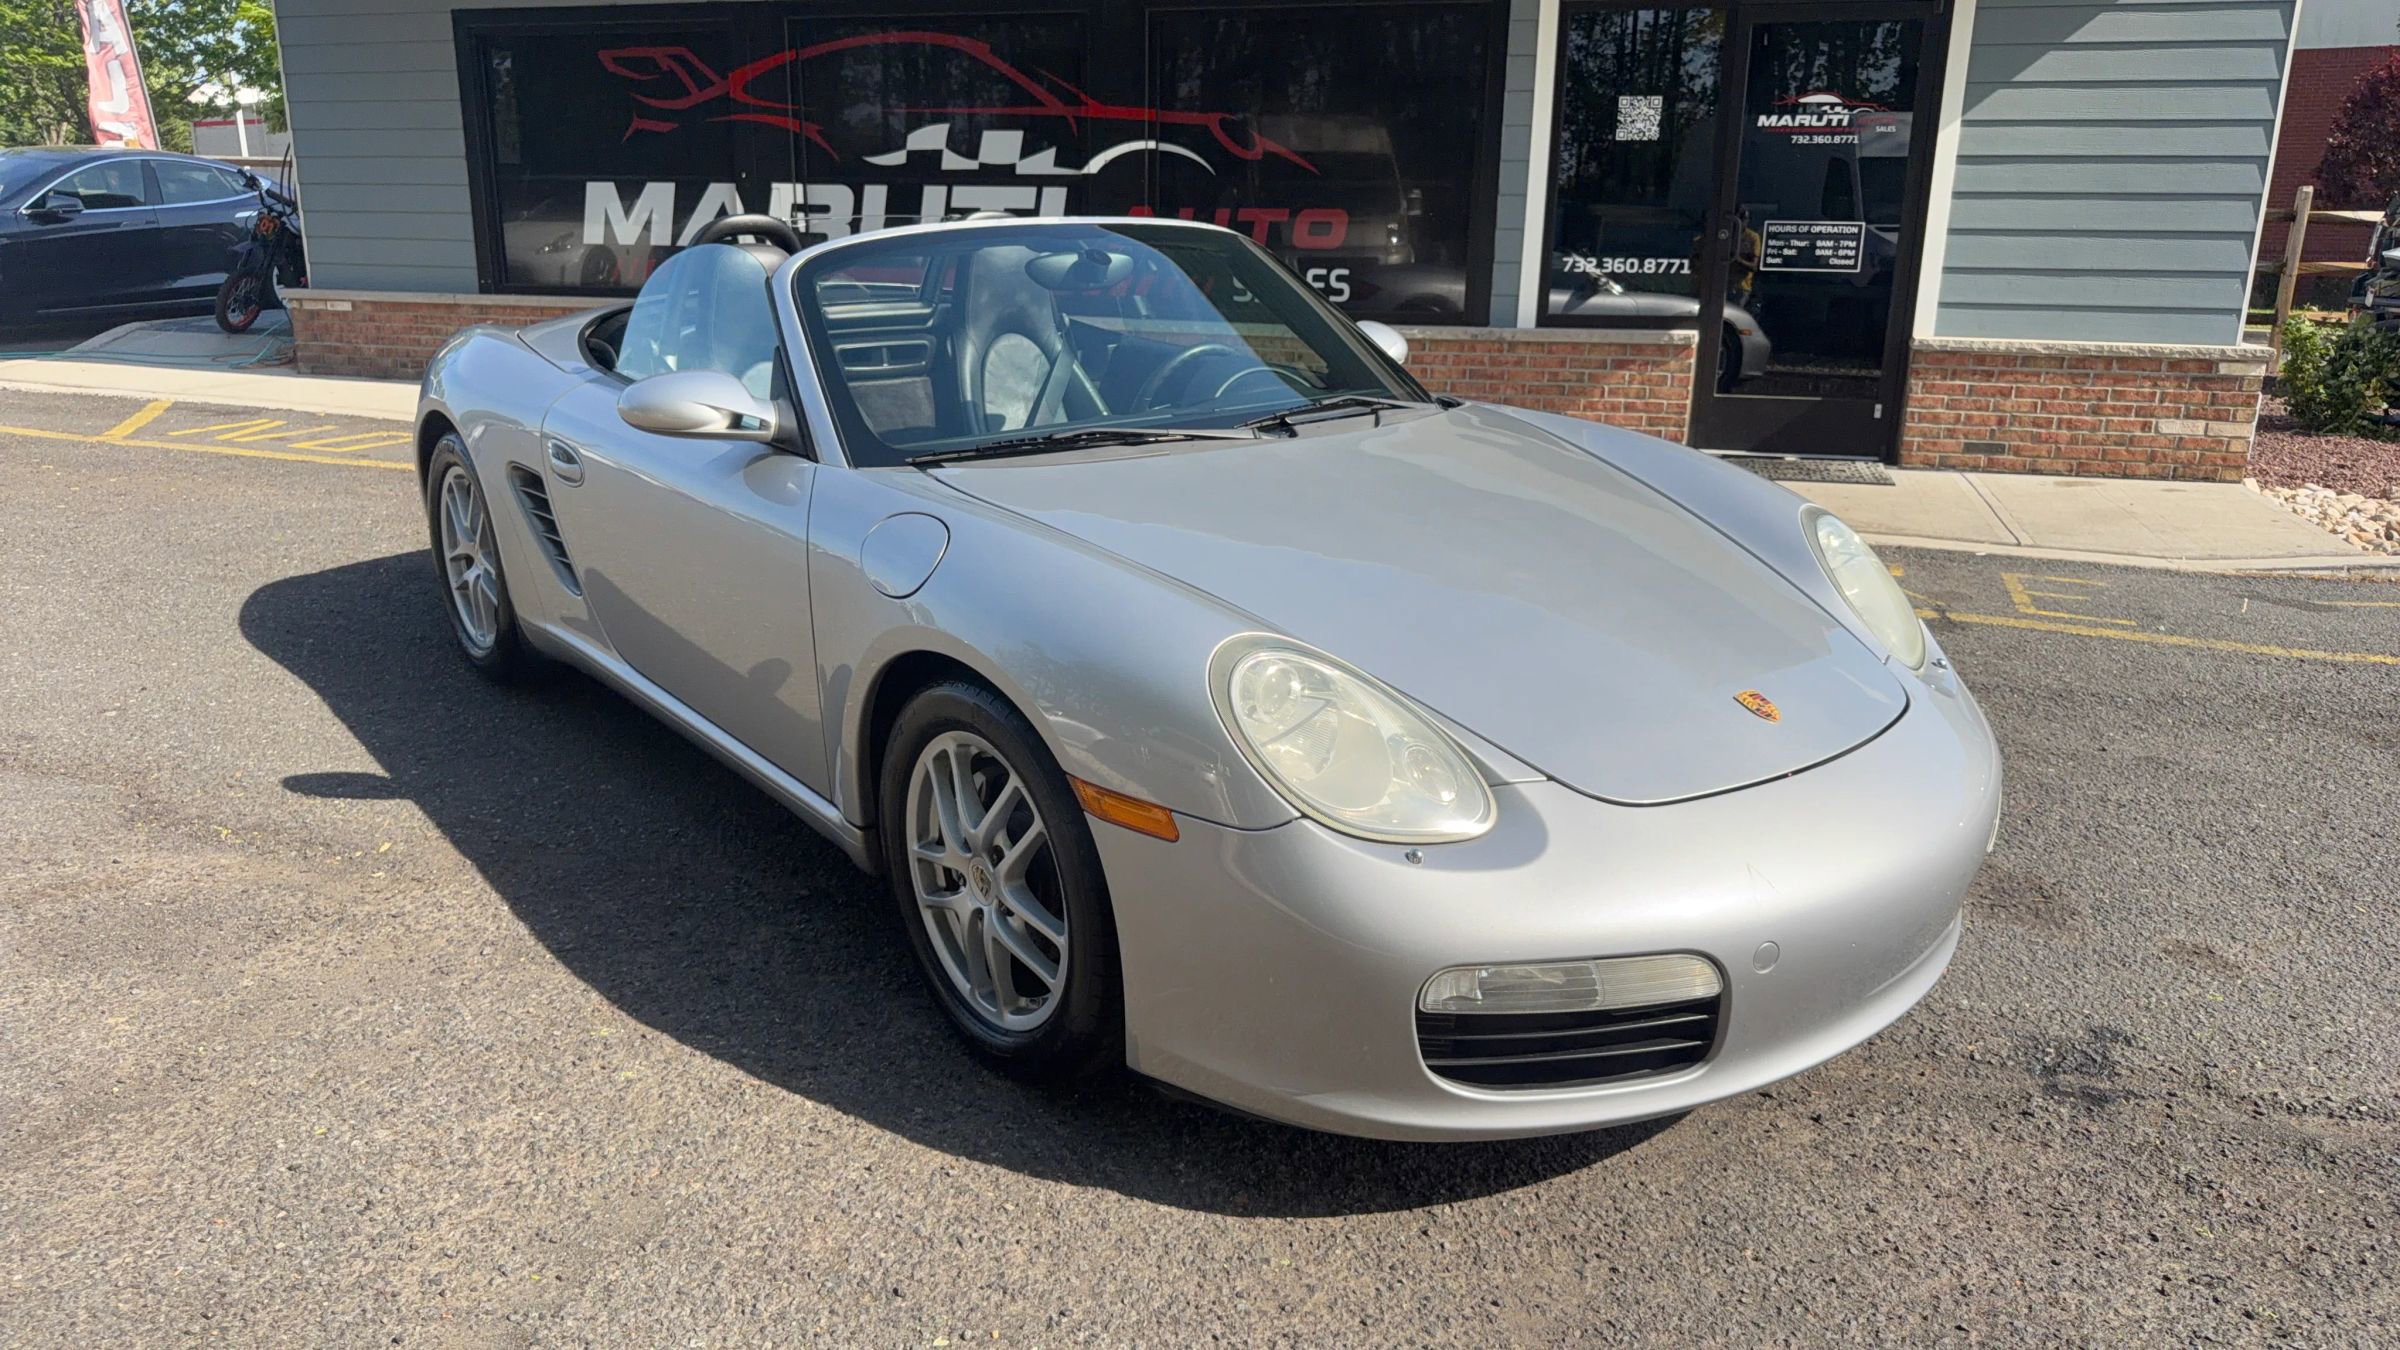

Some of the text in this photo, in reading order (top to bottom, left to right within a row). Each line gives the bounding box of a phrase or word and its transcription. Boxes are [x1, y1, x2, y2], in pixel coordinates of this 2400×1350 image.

[1757, 114, 1850, 127] MARUTI
[1875, 125, 1897, 133] SALES
[1791, 135, 1859, 144] 732.360.8771
[1128, 206, 1349, 250] TO
[1768, 225, 1858, 234] HOURS OF OPERATION
[1562, 257, 1691, 274] 732.360.8771
[1829, 257, 1855, 265] Closed
